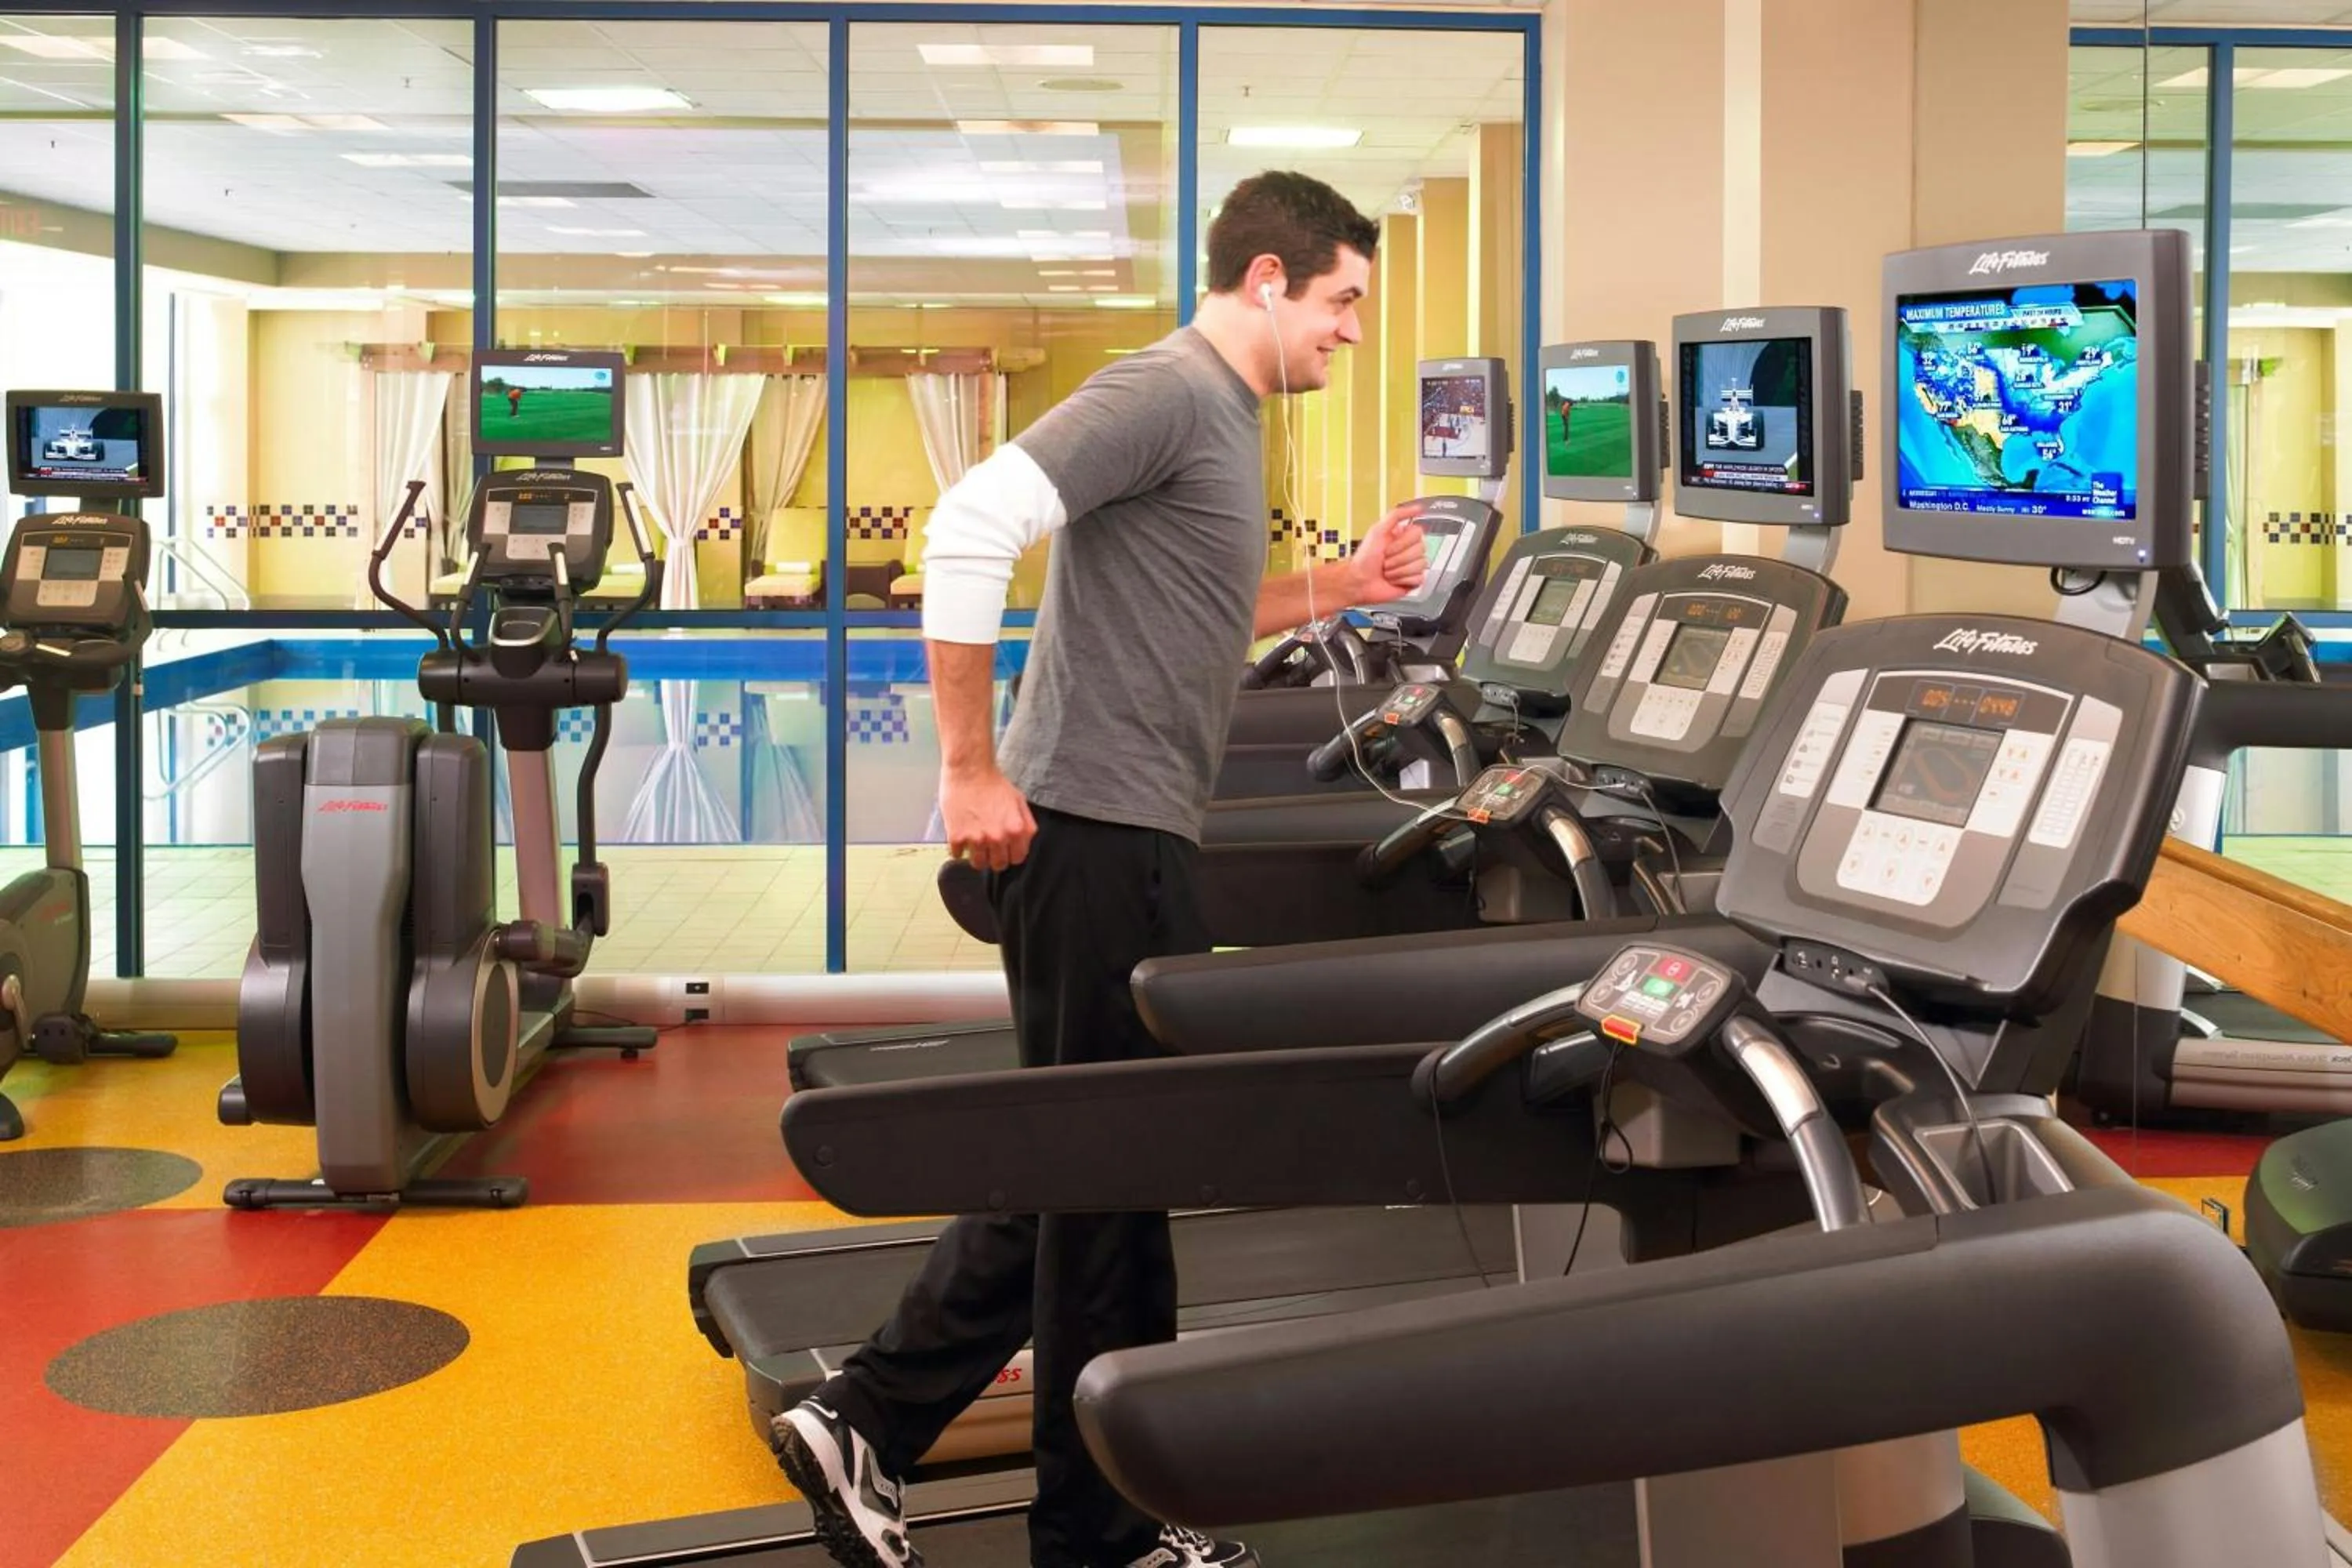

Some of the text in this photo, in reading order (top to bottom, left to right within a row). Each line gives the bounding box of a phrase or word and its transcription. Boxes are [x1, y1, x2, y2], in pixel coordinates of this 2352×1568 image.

[1906, 303, 2005, 321] MAXIMUM TEMPERATURES
[1909, 500, 1953, 510] Washington
